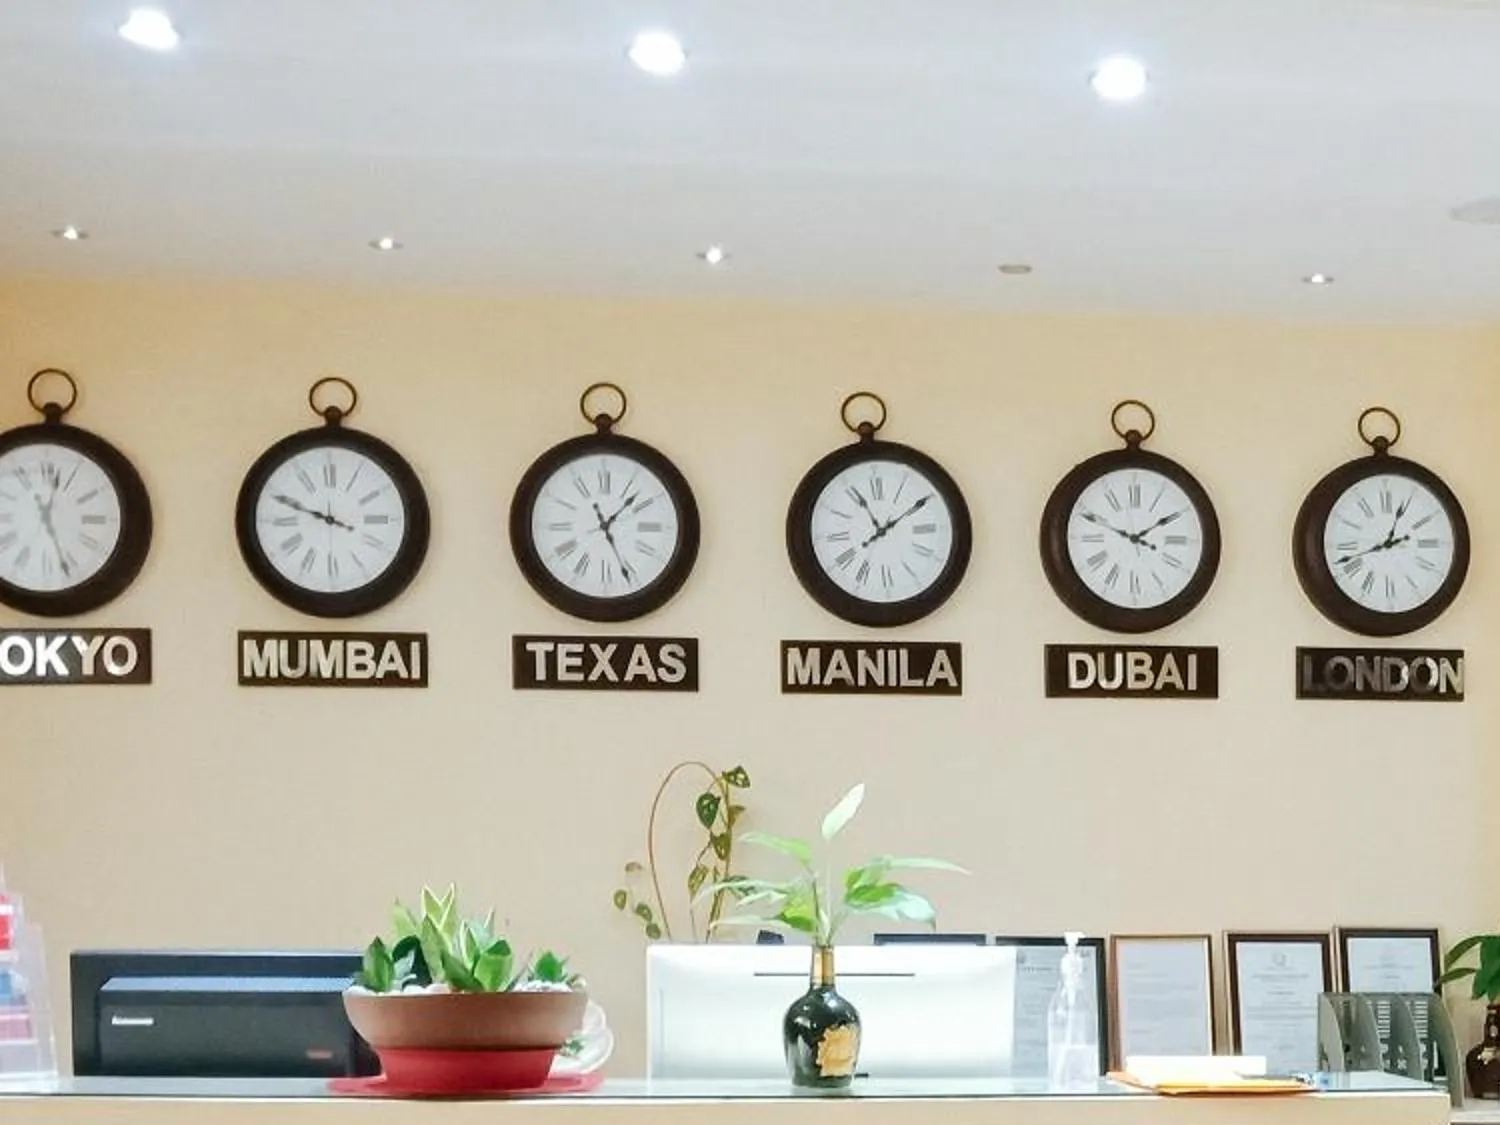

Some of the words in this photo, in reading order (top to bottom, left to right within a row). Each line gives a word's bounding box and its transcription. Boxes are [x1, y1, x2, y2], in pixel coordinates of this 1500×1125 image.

[0, 635, 138, 676] OKYO
[243, 640, 421, 681] MUMBAI
[526, 642, 687, 684] TEXAS
[786, 647, 958, 688] MANILA
[1068, 652, 1197, 690] DUBAI
[1303, 655, 1464, 693] LONDON
